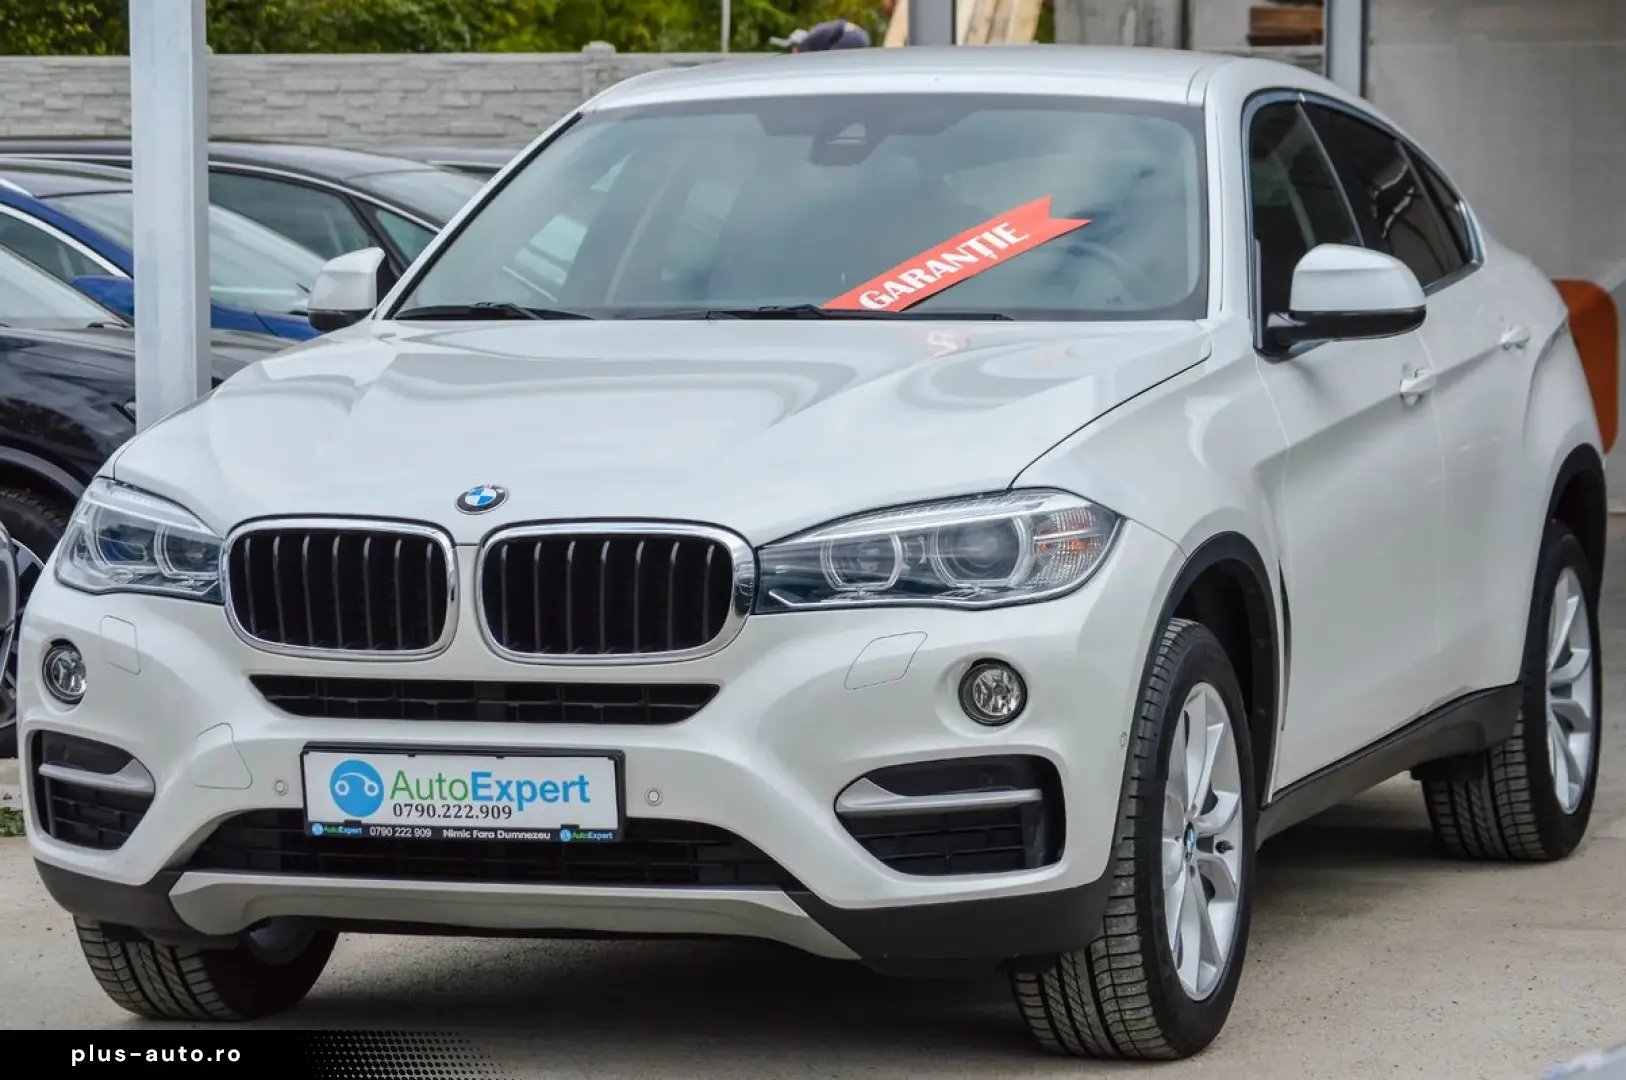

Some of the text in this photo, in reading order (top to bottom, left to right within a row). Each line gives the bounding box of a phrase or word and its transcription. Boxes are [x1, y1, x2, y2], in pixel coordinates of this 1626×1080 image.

[390, 770, 590, 812] AutoExpert
[392, 802, 513, 820] 0790.222.909
[369, 826, 432, 839] 0790 222 909
[443, 829, 551, 839] Nimic Fara Dumnezeu
